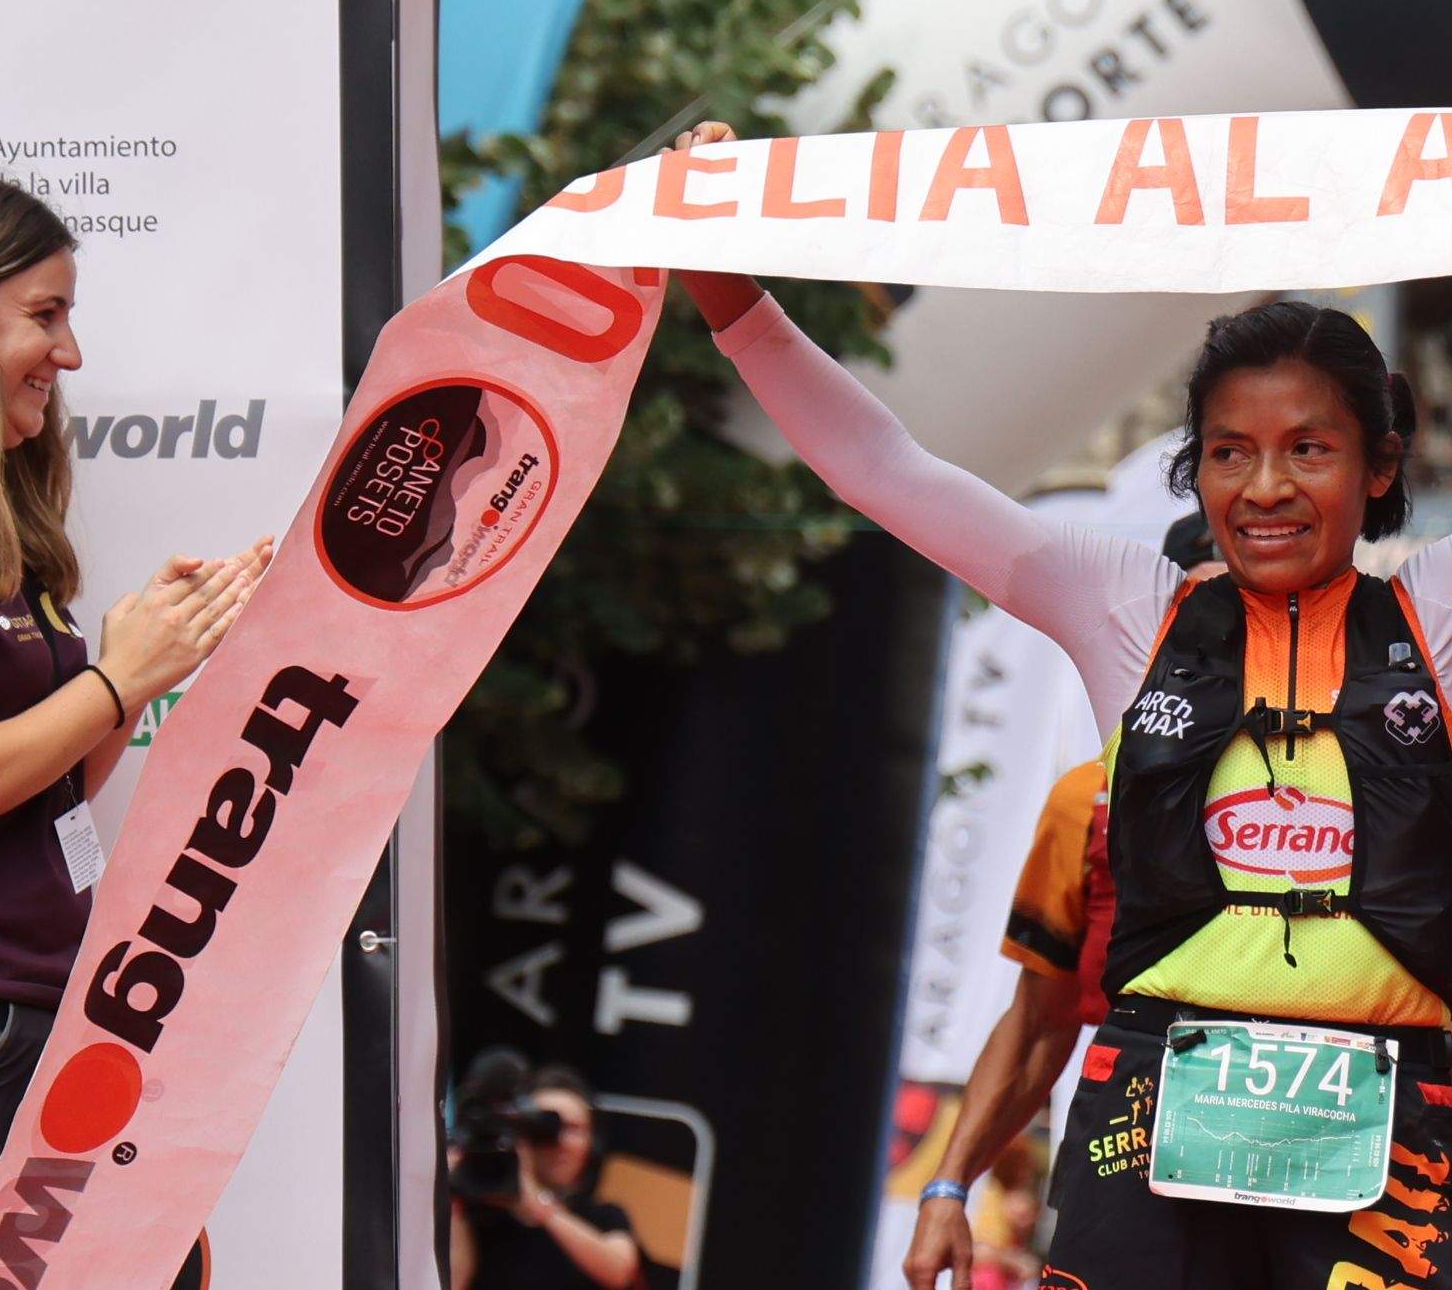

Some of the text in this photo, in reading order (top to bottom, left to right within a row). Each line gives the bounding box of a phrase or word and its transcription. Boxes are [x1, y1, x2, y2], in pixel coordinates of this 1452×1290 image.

[30, 172, 51, 195] la
[58, 172, 110, 195] villa
[1094, 116, 1310, 227] AL
[63, 214, 158, 238] nasque
[347, 426, 423, 527] POSETS
[376, 460, 441, 537] ANETO
[479, 480, 542, 567] GRAN TRAIL
[1131, 712, 1196, 740] MAX
[594, 858, 705, 1036] TV
[1210, 1042, 1353, 1107] 1574
[1194, 1094, 1357, 1122] MARIA MERCEDES PILA VIRACOCHA
[1098, 1159, 1128, 1177] CLUB
